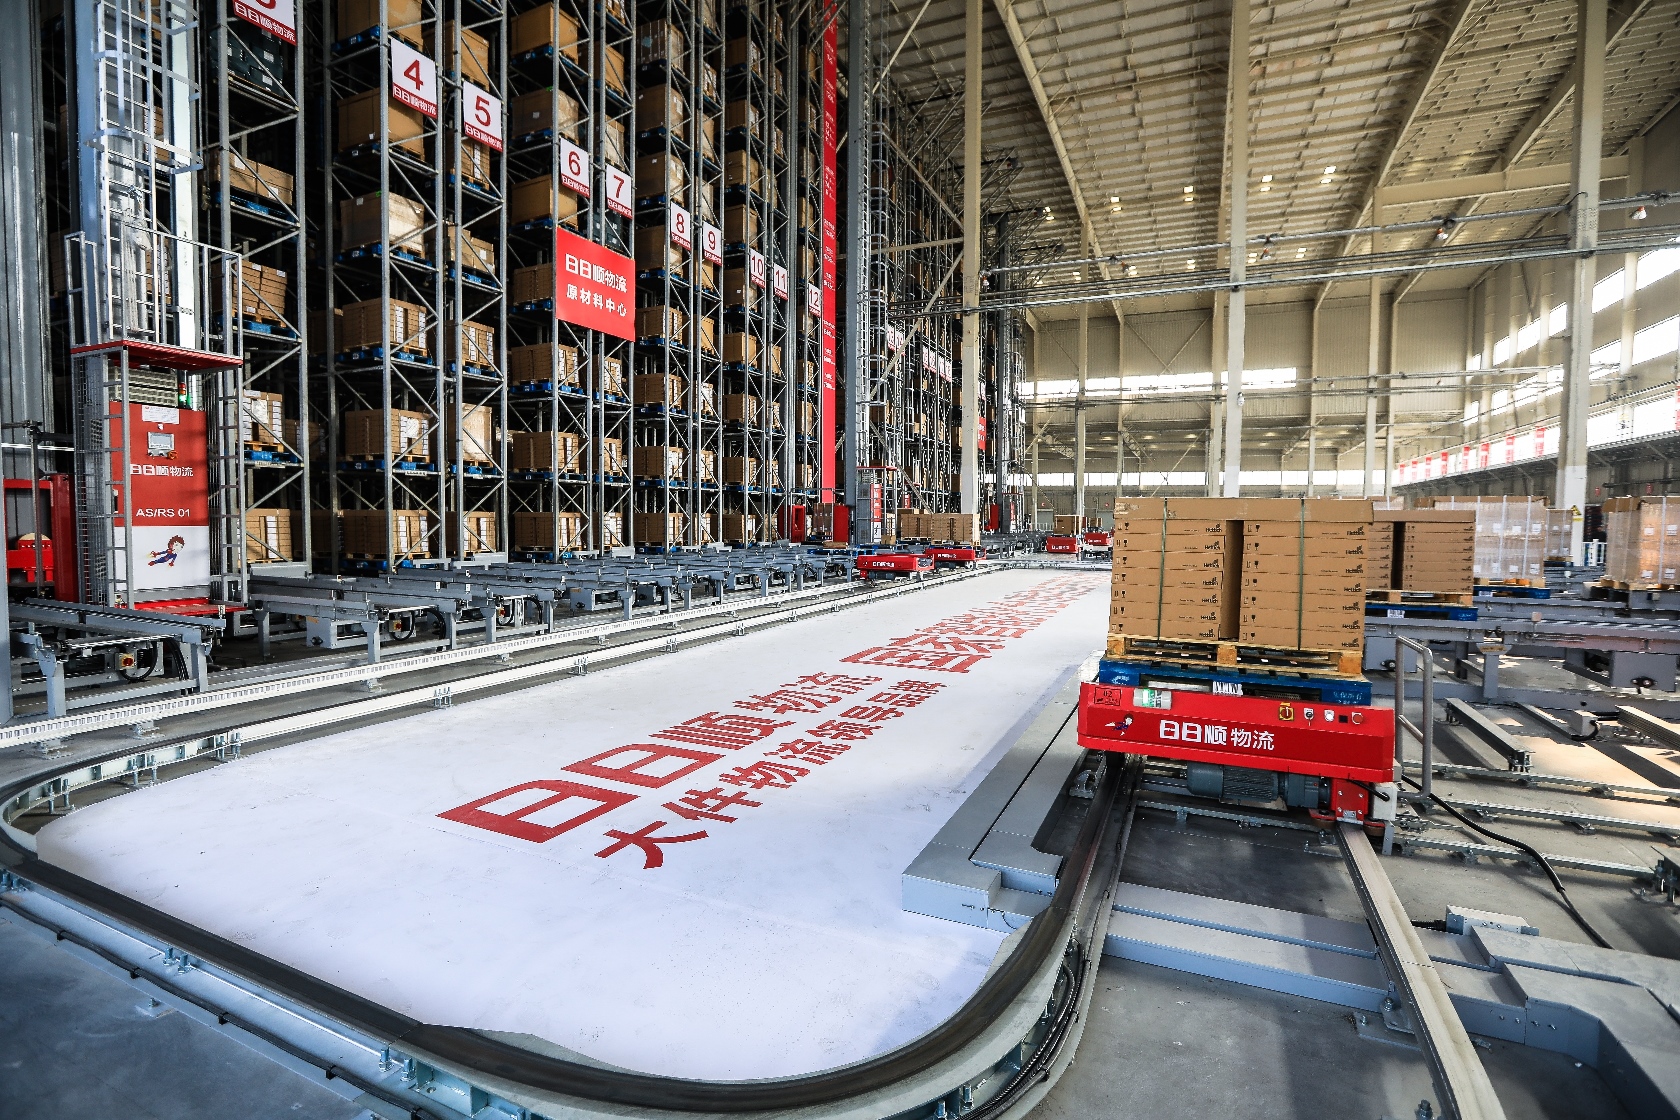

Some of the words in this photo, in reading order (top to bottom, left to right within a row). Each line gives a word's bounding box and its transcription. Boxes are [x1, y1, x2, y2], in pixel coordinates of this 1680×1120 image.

[234, 2, 296, 42] 日日顺物流
[403, 59, 424, 91] 4
[474, 95, 492, 127] 5
[568, 151, 581, 177] 6
[613, 174, 625, 199] 7
[676, 212, 685, 234] 8
[708, 230, 716, 251] 9
[565, 253, 628, 294] 日日顺物流
[751, 254, 764, 277] 10
[775, 269, 786, 290] 11
[566, 283, 627, 317] 原材料中心
[809, 288, 819, 308] 12
[130, 463, 194, 477] 日日顺物流
[135, 508, 175, 518] AS/RS
[177, 508, 191, 517] 01
[1159, 719, 1275, 751] 日日顺物流
[438, 672, 882, 843] 日日顺物流
[596, 680, 941, 868] 大件物流领导品牌
